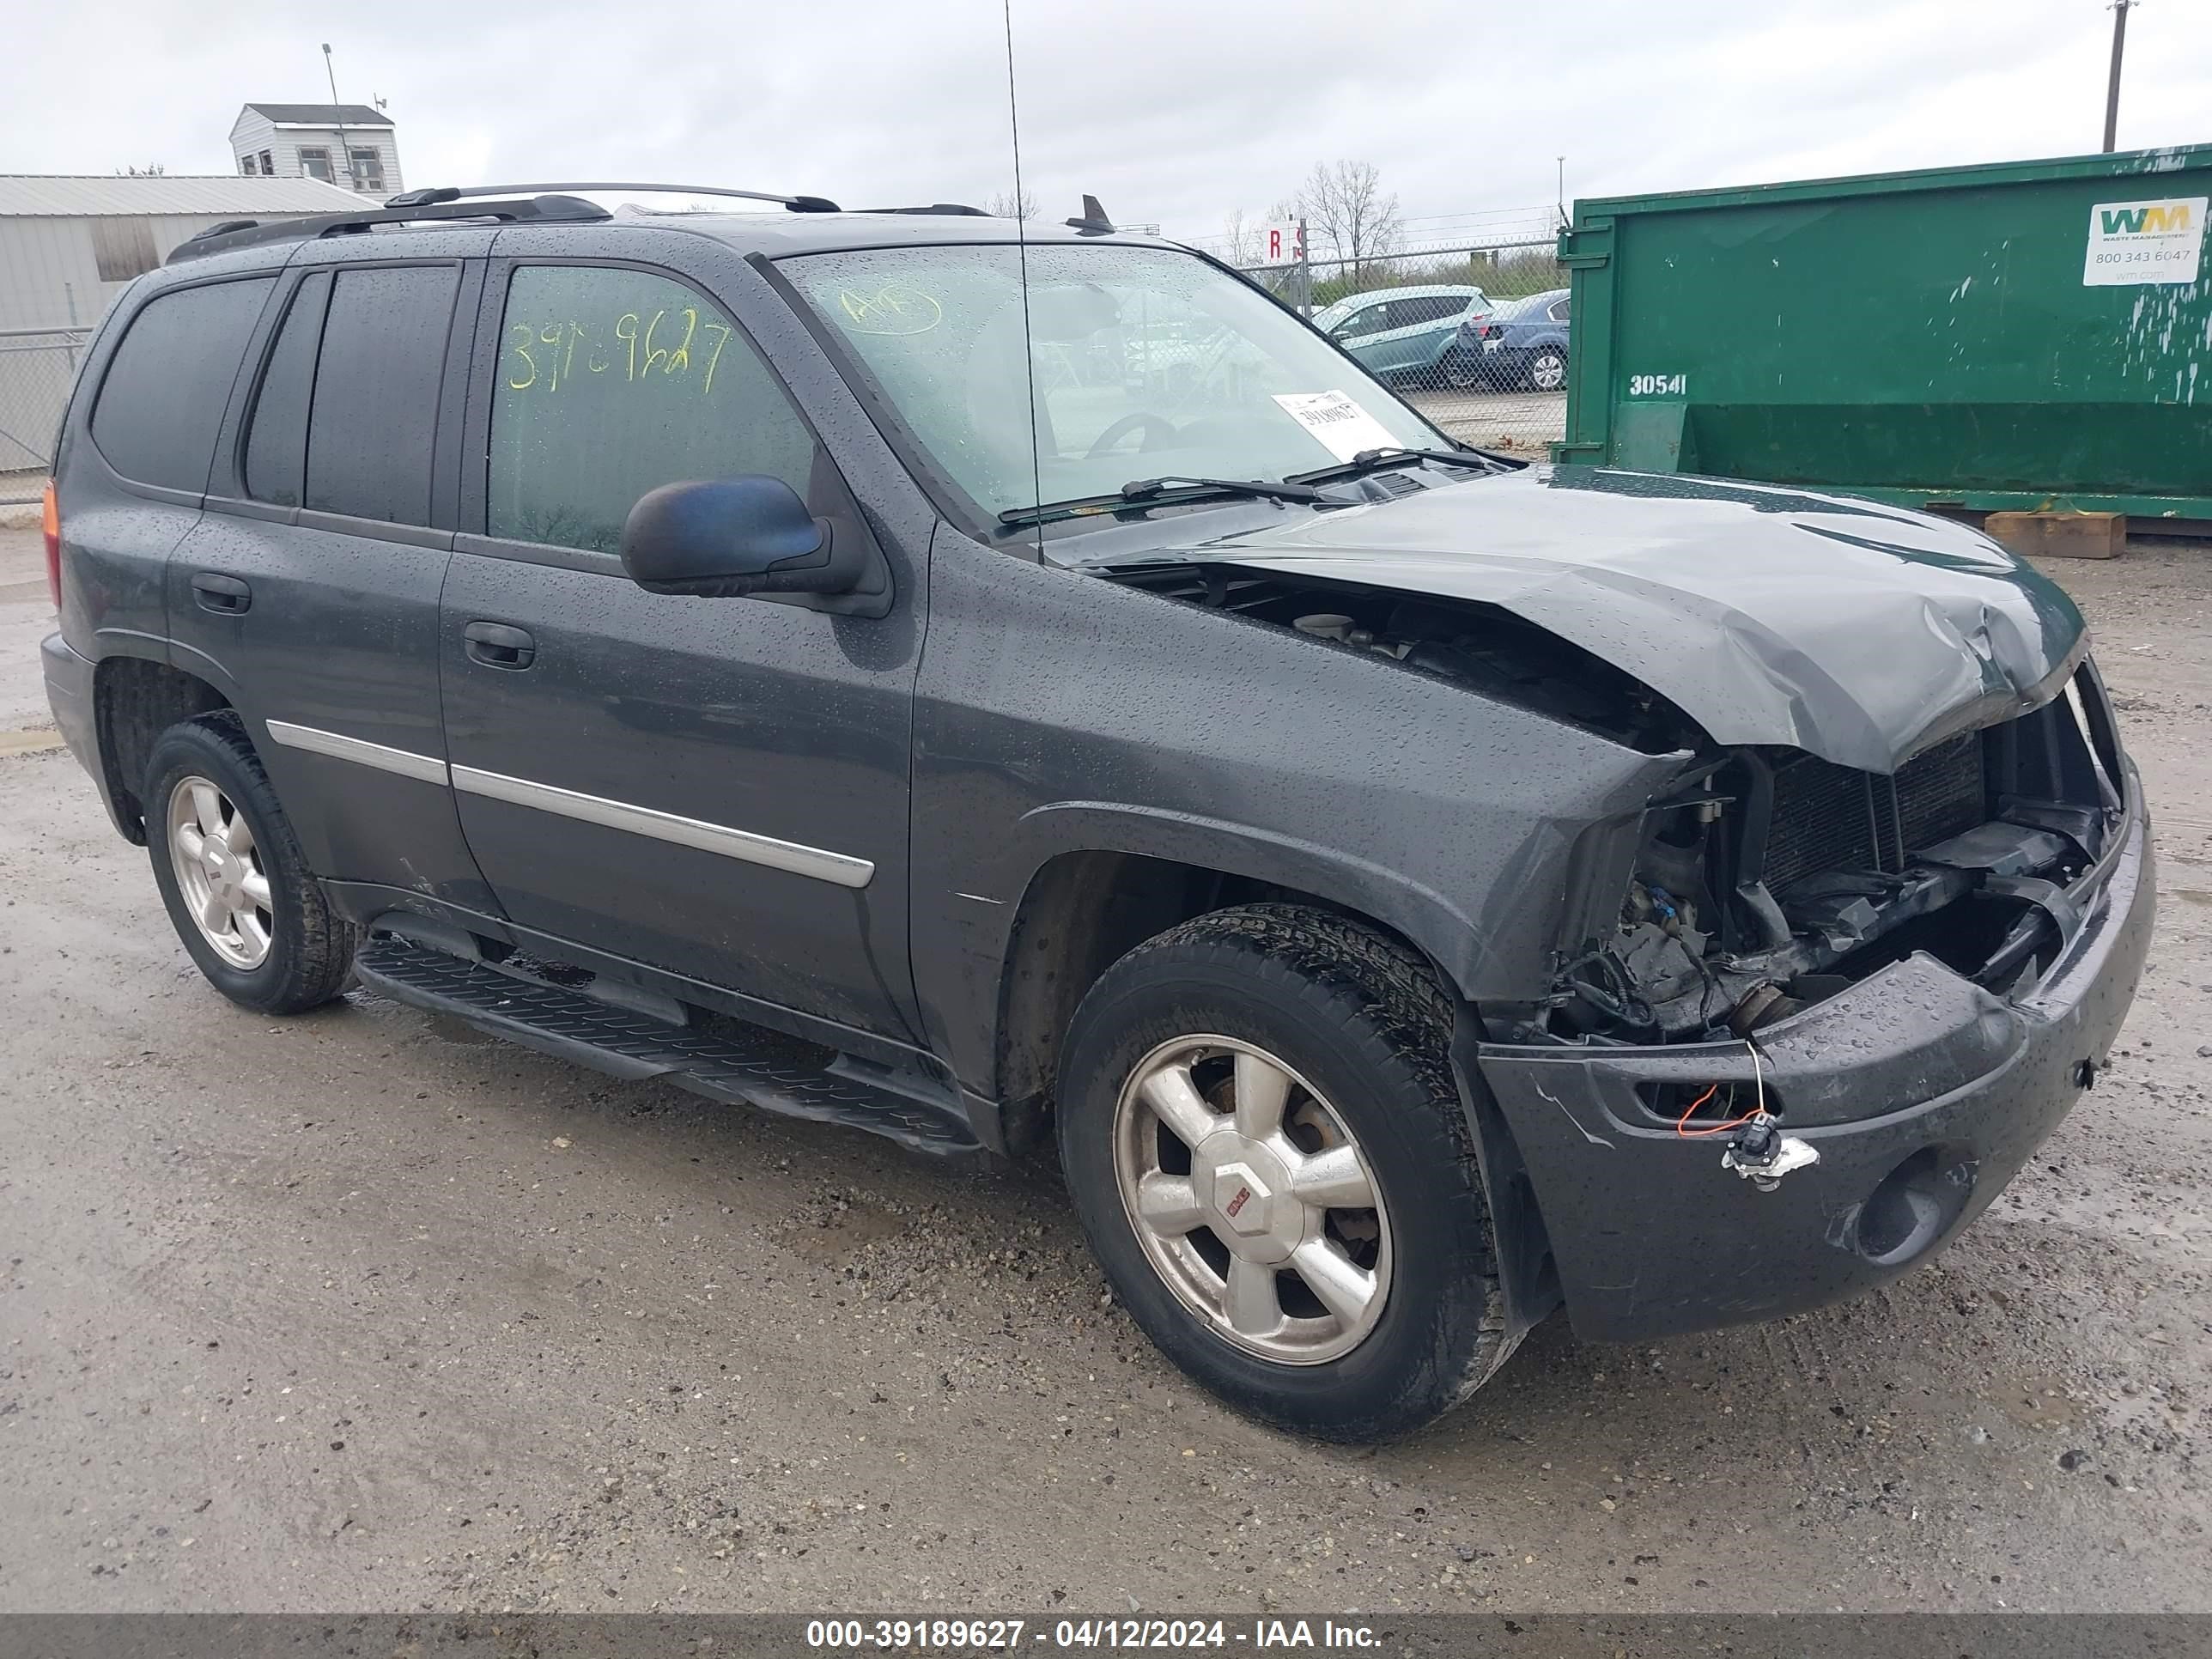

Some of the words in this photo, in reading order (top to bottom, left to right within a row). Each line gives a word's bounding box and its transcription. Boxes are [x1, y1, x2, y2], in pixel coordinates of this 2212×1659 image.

[2100, 205, 2191, 234] WM
[1270, 230, 1280, 258] R
[2096, 253, 2122, 264] 800
[2124, 252, 2150, 263] 343
[2155, 250, 2191, 261] 6047
[1630, 374, 1686, 395] 30541
